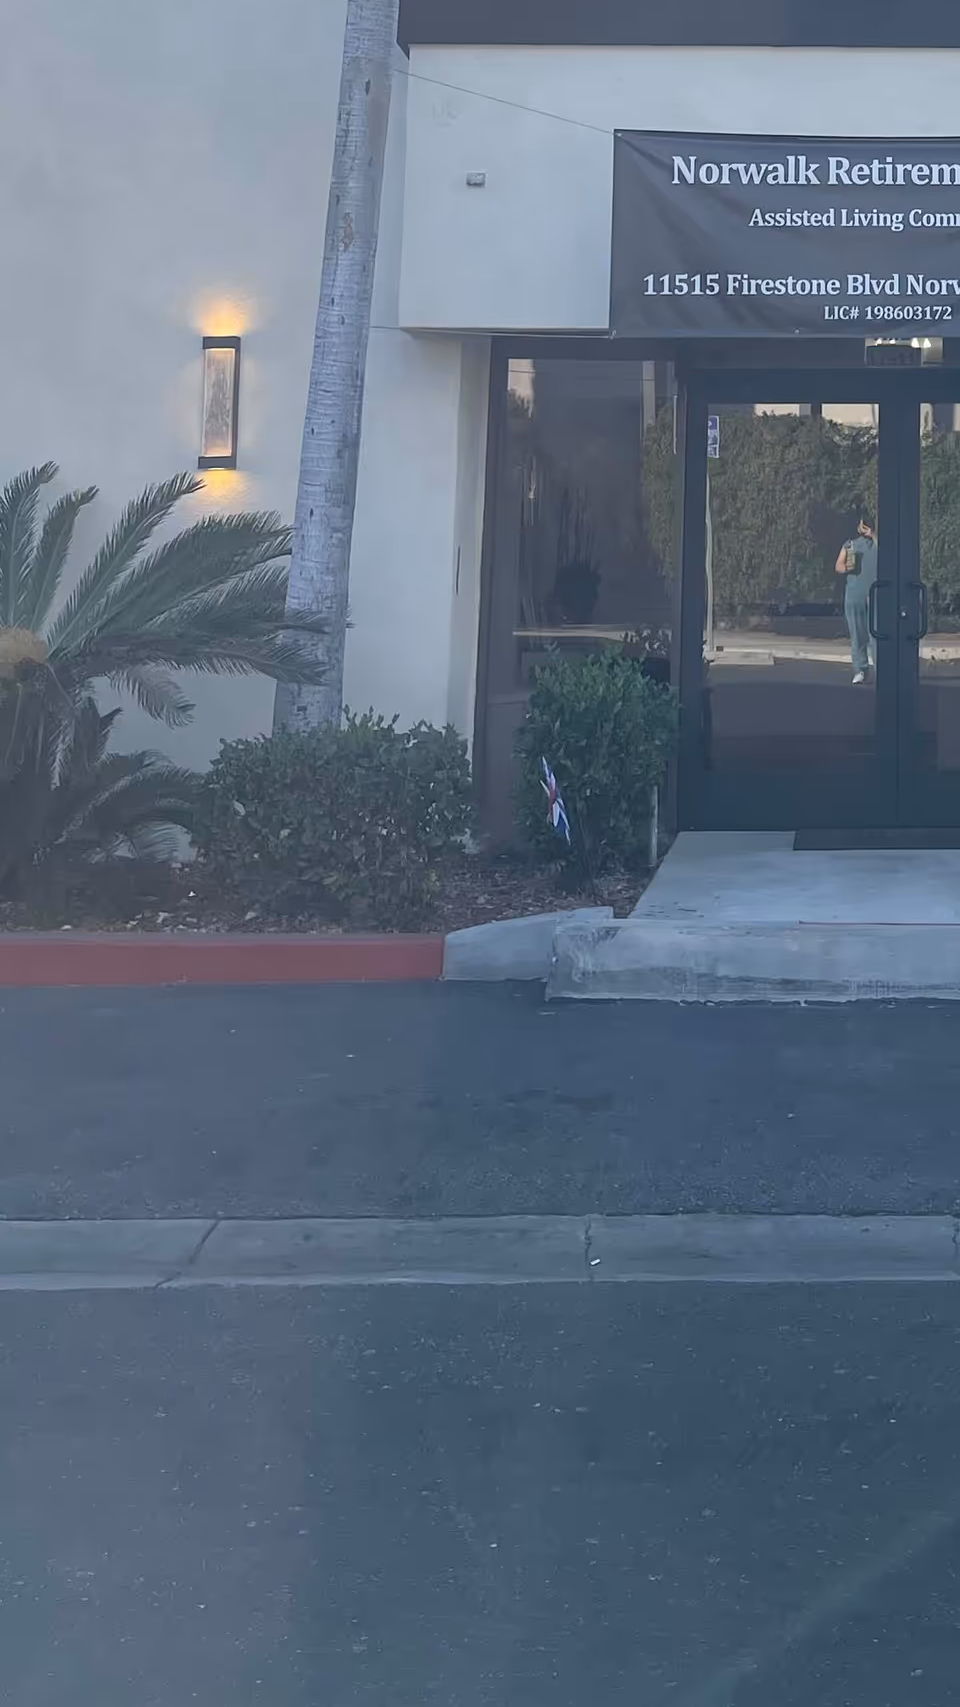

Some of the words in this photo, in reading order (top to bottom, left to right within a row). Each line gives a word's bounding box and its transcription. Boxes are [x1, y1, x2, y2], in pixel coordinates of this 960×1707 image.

[671, 155, 821, 185] Norwalk
[748, 208, 836, 227] Assisted
[840, 208, 905, 232] Living
[643, 273, 720, 295] 11515
[726, 273, 841, 295] Firestone
[846, 273, 901, 295] Blvd
[824, 305, 860, 320] LIC#
[864, 305, 952, 320] 198603172
